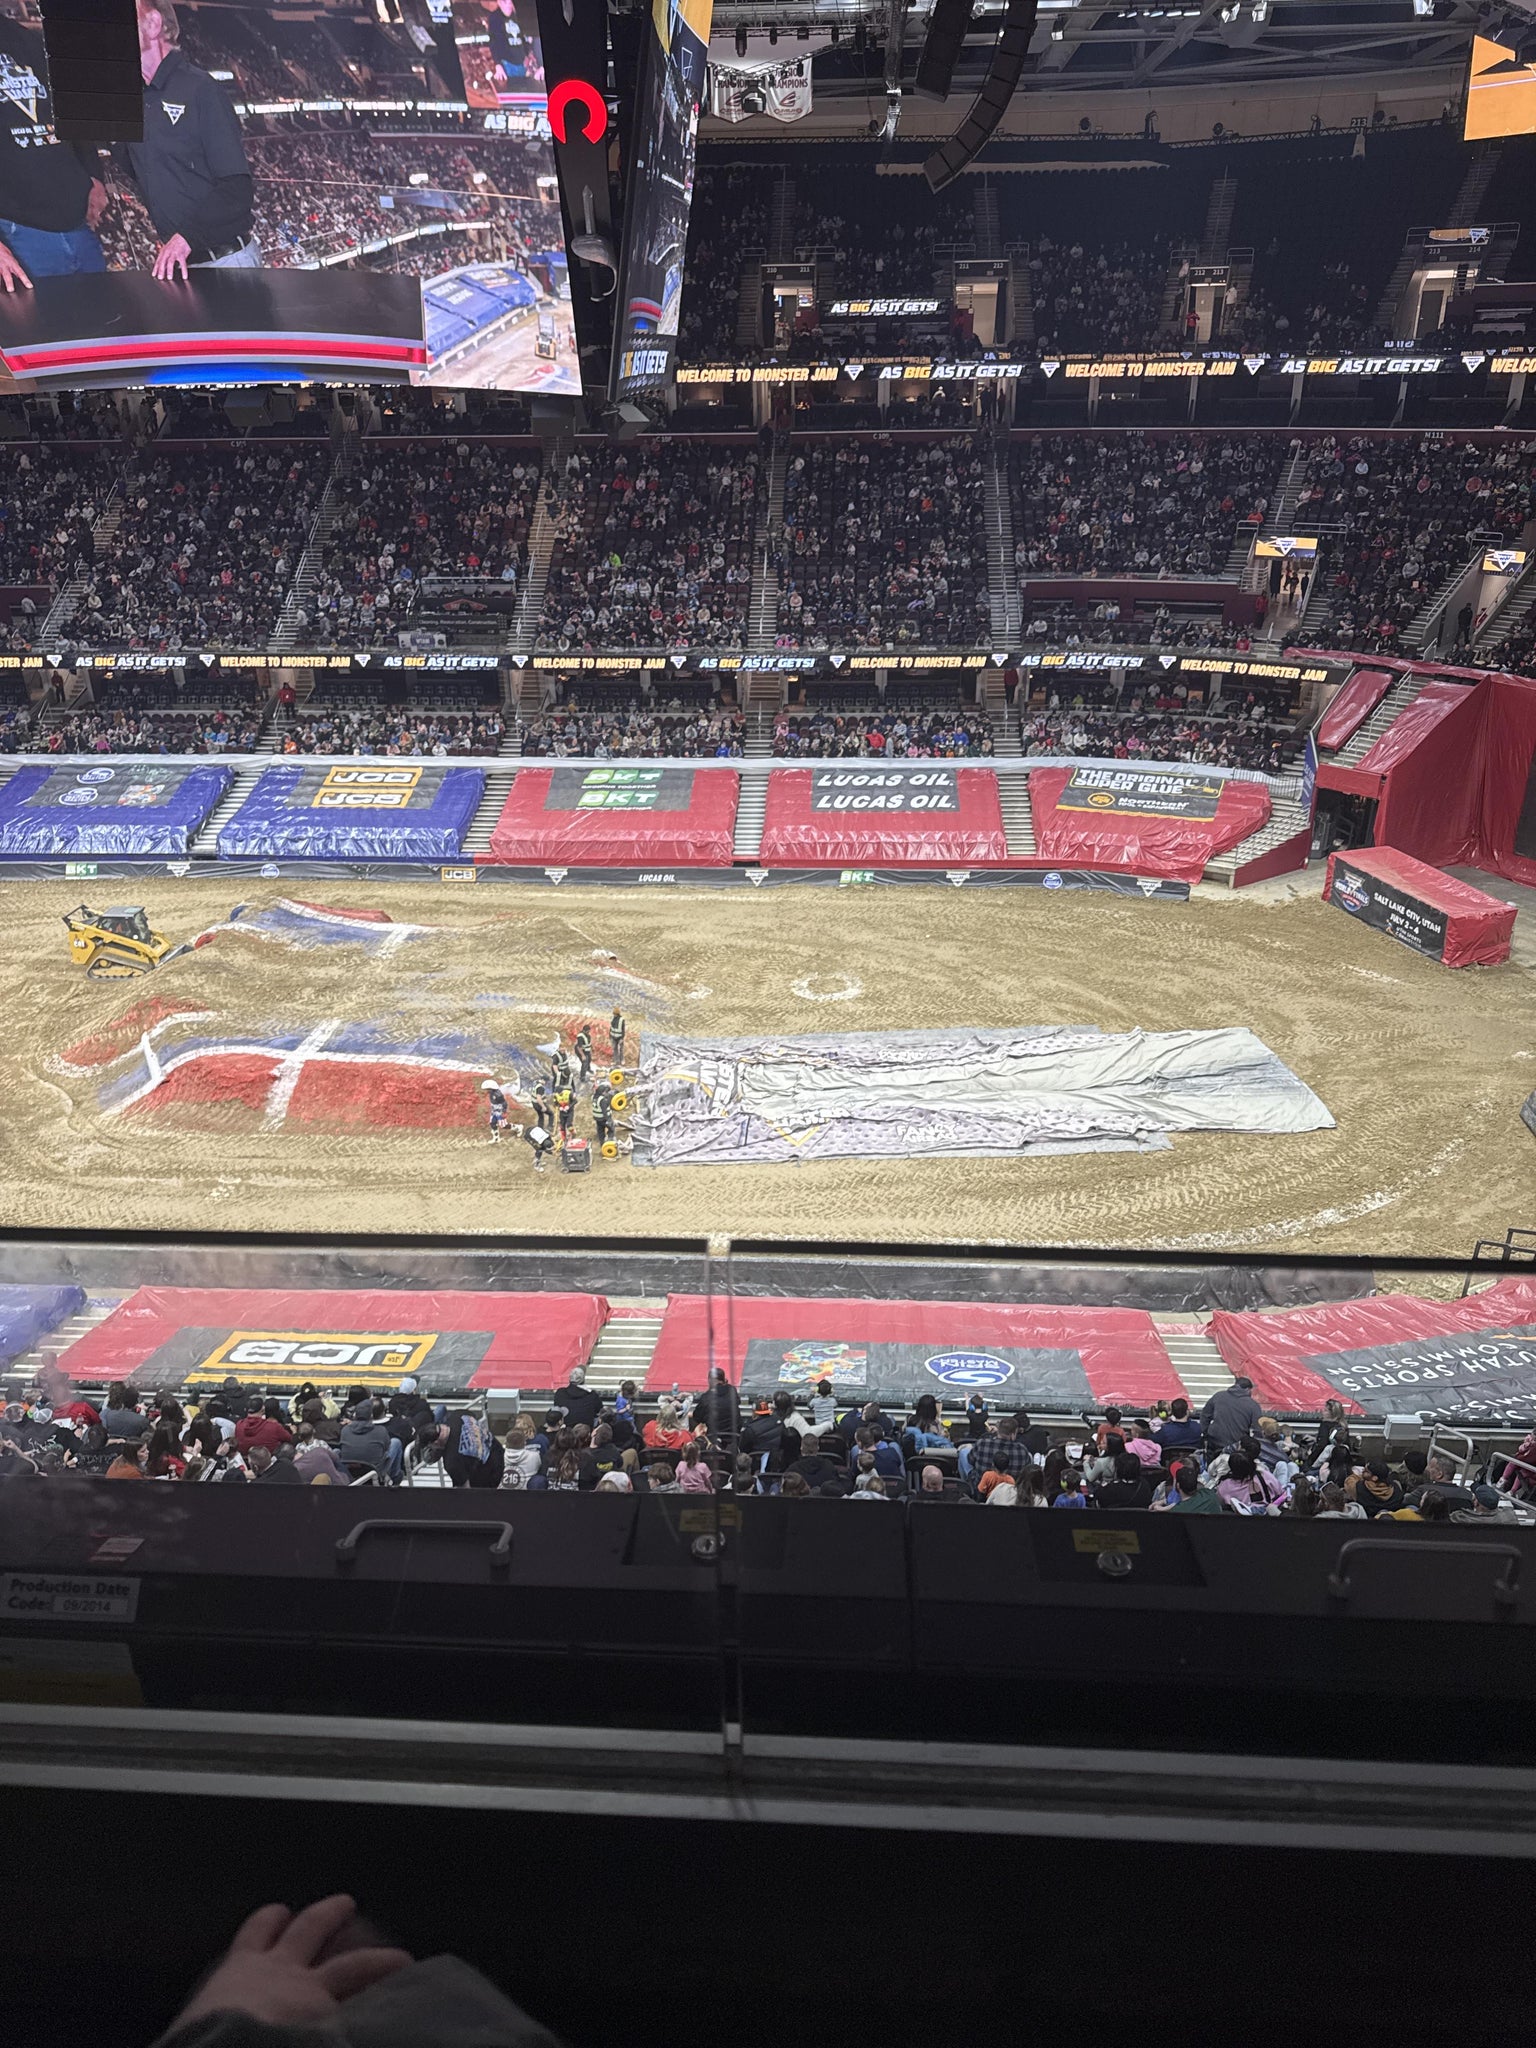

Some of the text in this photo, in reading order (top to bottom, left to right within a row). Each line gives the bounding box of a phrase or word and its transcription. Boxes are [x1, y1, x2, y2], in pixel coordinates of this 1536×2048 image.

[831, 302, 939, 313] AS BIG AS IT GETS!
[879, 365, 1023, 379] AS BIG AS IT GETS!
[1065, 361, 1237, 377] WELCOME TO MONSTER JAM
[1280, 359, 1440, 373] AS BIG AS IT GETS!
[676, 367, 838, 383] WELCOME TO MONSTER JAM
[22, 657, 43, 667] JAM
[76, 657, 186, 667] AS BIG AS IT GETS!
[220, 657, 350, 668] WELCOME TO MONSTER JAM
[384, 657, 498, 667] AS BIG AS IT GETS!
[533, 658, 666, 669] WELCOME TO MONSTER JAM
[699, 657, 815, 668] AS BIG AS IT GETS!
[850, 656, 987, 669] WELCOME TO MONSTER JAM
[1020, 656, 1144, 667] AS BIG AS IT GETS!
[1180, 658, 1327, 682] WELCOME TO MONSTER JAM
[333, 771, 412, 783] JCB
[588, 772, 661, 783] BKT
[817, 774, 904, 787] LUCAS
[1079, 769, 1113, 780] THE
[1074, 777, 1184, 794] SUPER GLUE
[321, 793, 403, 805] JCB
[580, 793, 656, 804] BKT
[817, 795, 905, 809] LUCAS
[66, 864, 97, 875] BKT
[444, 869, 473, 880] JCB
[638, 873, 676, 882] LUCAS OIL
[841, 871, 874, 883] BKT
[1373, 892, 1441, 934] SALT LAKE CITY, UTAH
[1390, 912, 1405, 925] JULY
[229, 1341, 413, 1365] JCB
[1326, 1342, 1518, 1375] COMMISSION
[1342, 1350, 1536, 1391] UTAH SPORTS
[503, 1473, 519, 1484] 216
[10, 1578, 130, 1596] Production Date
[7, 1596, 111, 1612] Code: 09/2014
